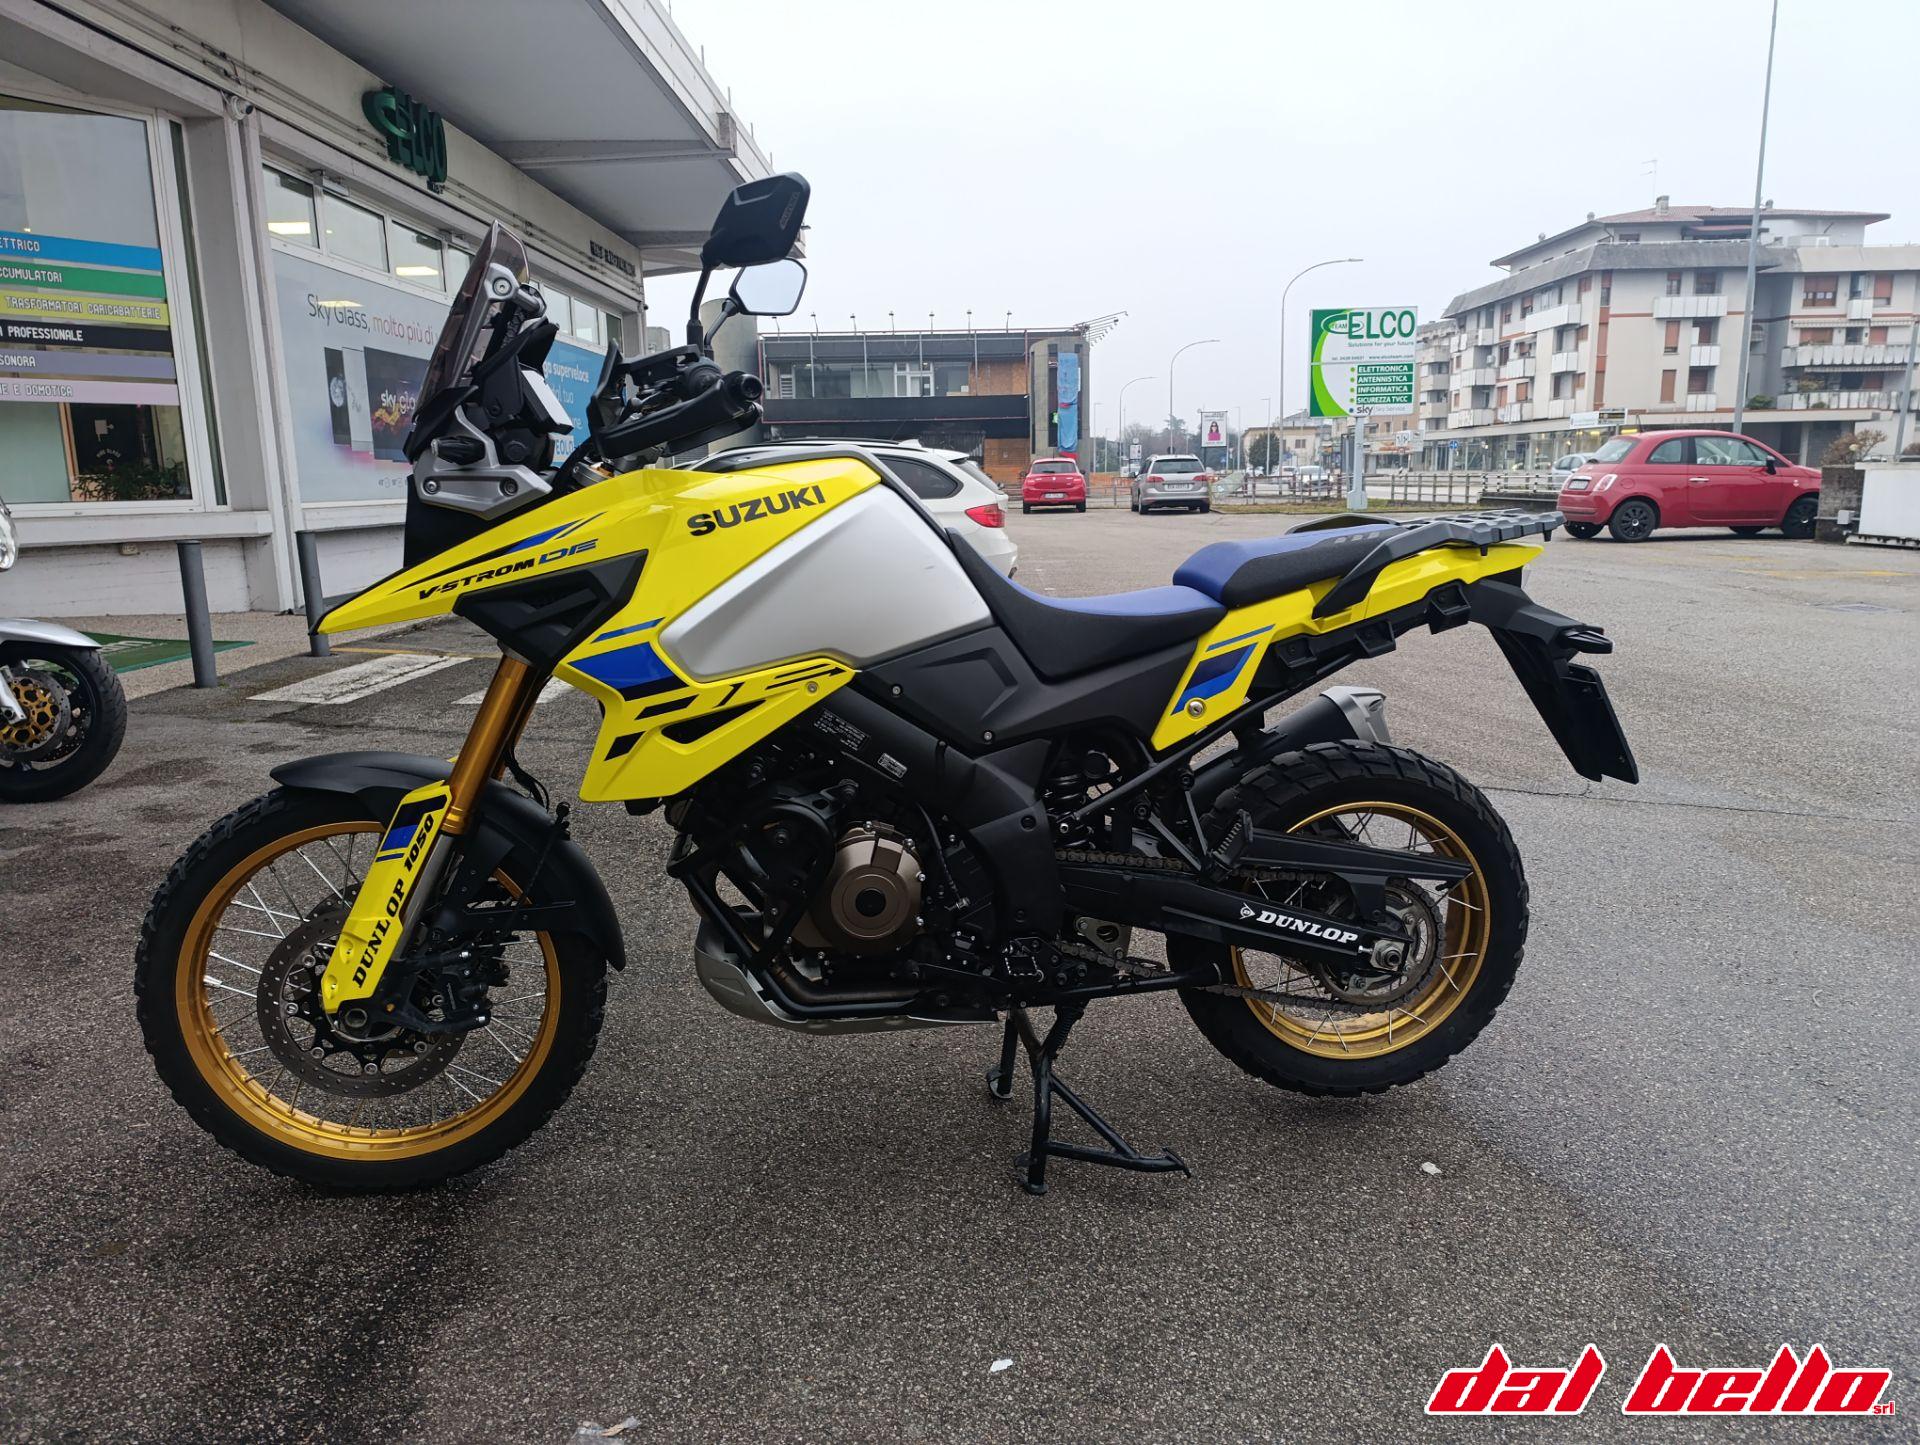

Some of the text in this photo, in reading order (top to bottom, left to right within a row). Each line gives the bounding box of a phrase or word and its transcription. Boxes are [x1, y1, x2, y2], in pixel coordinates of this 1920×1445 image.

[6, 296, 161, 320] TRASFORMATORI CARICABATTERIE
[8, 325, 84, 342] PROFESSIONALE
[372, 313, 405, 339] molto
[425, 325, 434, 345] di
[1348, 310, 1415, 339] ELCO
[553, 362, 590, 383] superveloce
[1358, 365, 1408, 373] ELETTRONICA
[1358, 375, 1408, 383] ANTENNISTICA
[13, 384, 20, 396] E
[26, 385, 74, 397] DOMOTICA
[381, 389, 397, 411] sky
[1358, 385, 1408, 393] INFORMATICA
[1358, 396, 1390, 404] SICUREZZA
[687, 484, 826, 537] SUZUKI
[419, 537, 599, 600] V-STROM DE
[352, 814, 435, 988] DUNLOP 1050
[1256, 910, 1359, 944] DUNLOP
